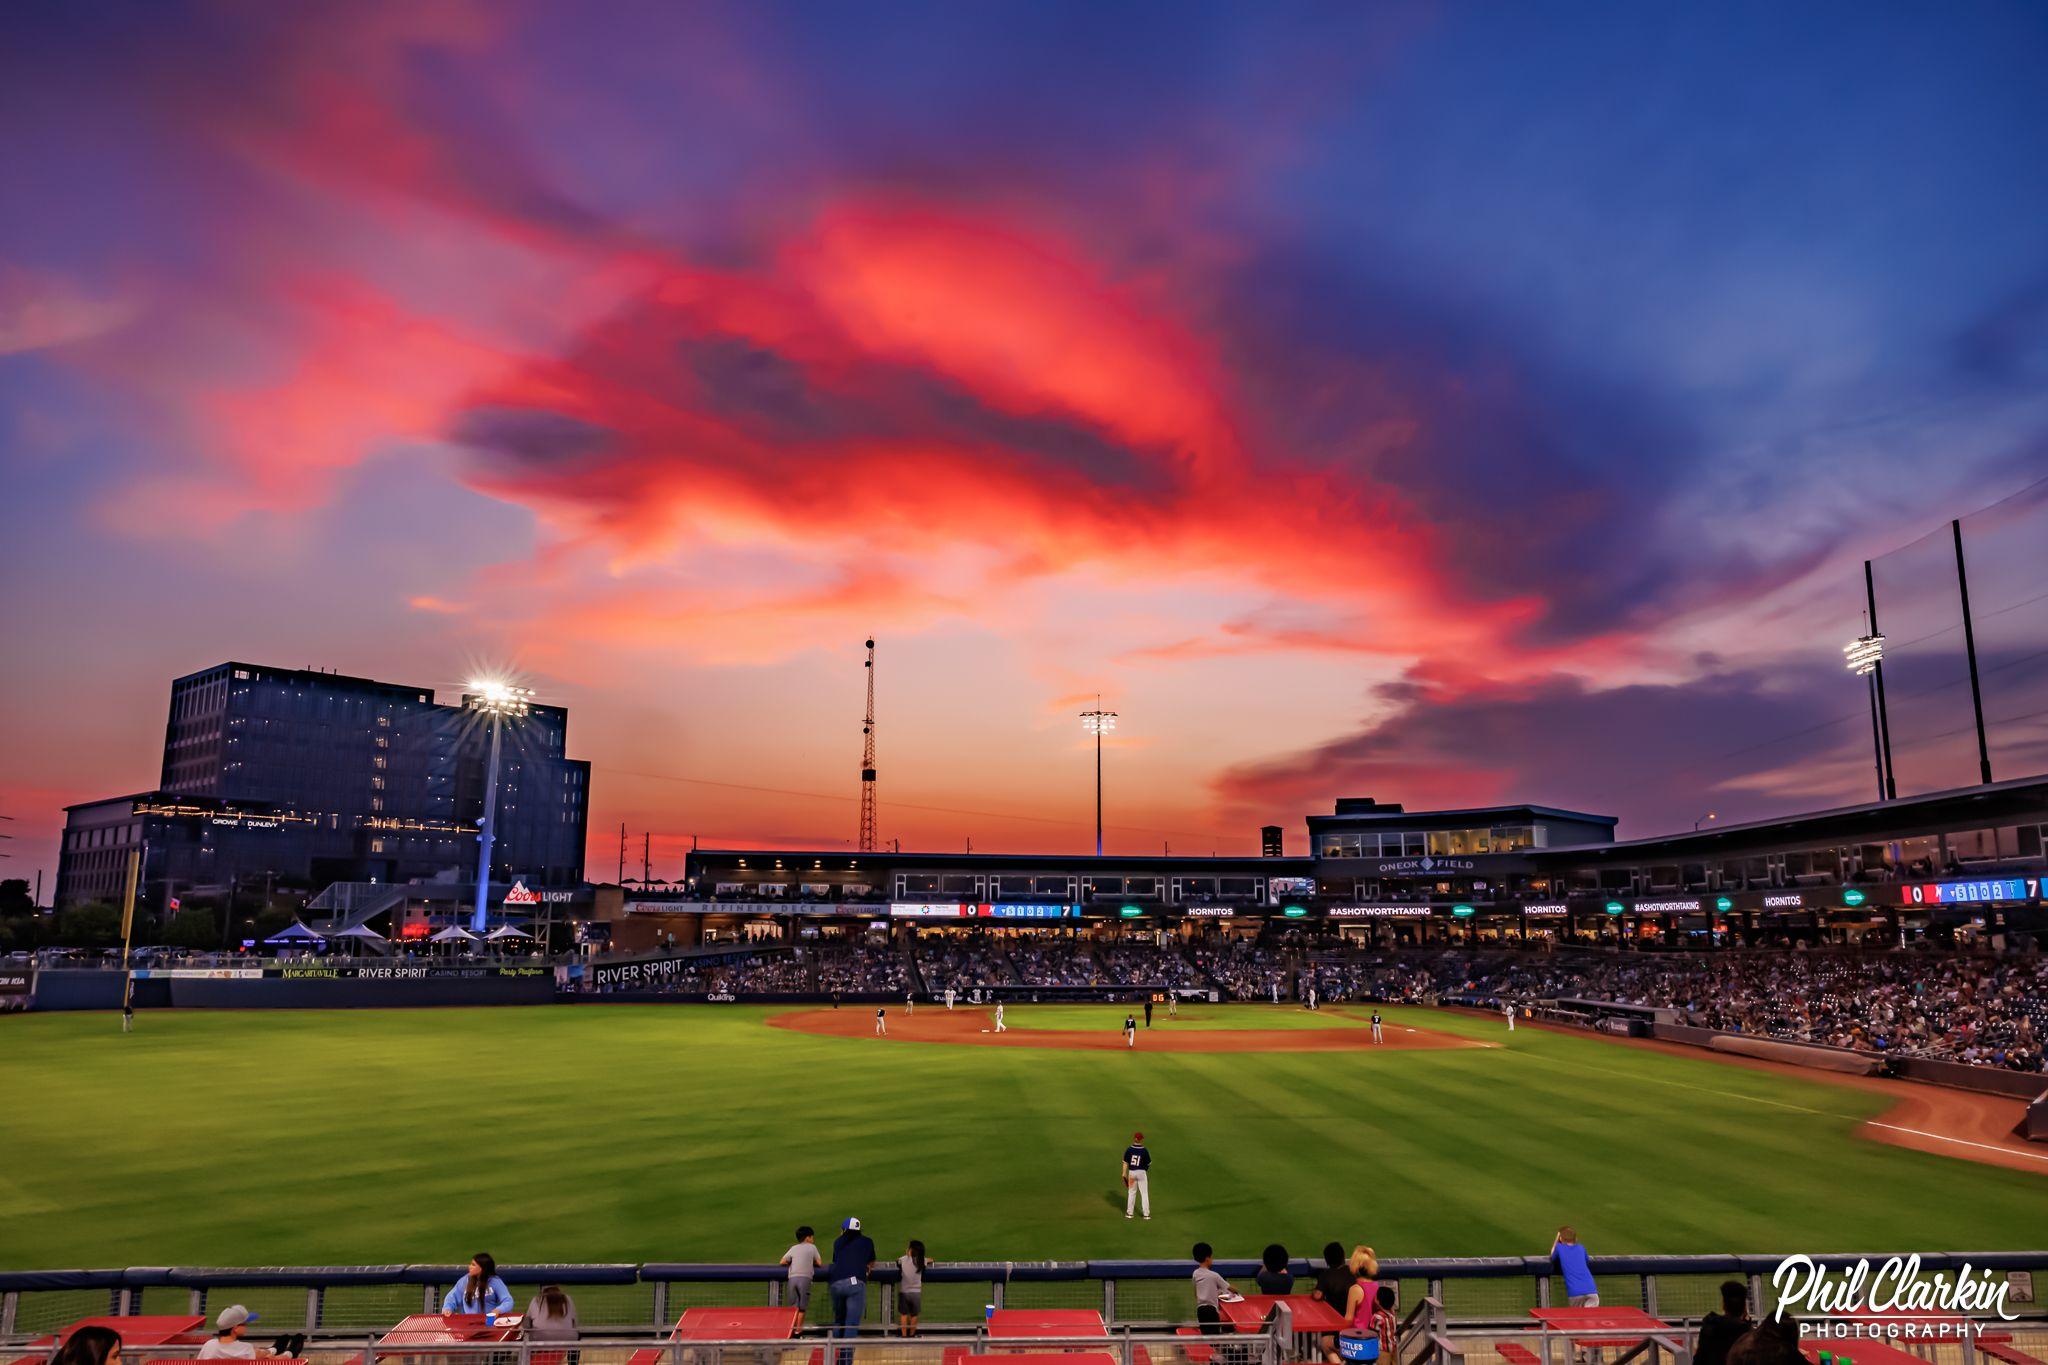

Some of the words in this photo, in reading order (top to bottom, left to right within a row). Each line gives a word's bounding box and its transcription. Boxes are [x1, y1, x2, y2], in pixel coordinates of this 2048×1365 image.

[212, 818, 238, 826] CROWE
[247, 820, 278, 828] DUNLEVY
[1379, 860, 1419, 872] ONEOK
[1437, 859, 1474, 869] FIELD
[370, 876, 377, 885] 2
[505, 886, 542, 903] Coors
[543, 891, 573, 903] LIGHT
[1912, 887, 1923, 903] 0
[2027, 880, 2037, 898] 7
[1765, 895, 1801, 907] HORNITOS
[702, 903, 772, 913] REFINERY
[781, 904, 816, 913] DECK
[967, 905, 976, 915] 0
[1062, 906, 1071, 916] 7
[1329, 907, 1431, 916] #ASHOTWORTHTAKING
[1524, 905, 1567, 914] HORNITOS
[1635, 901, 1700, 912] #ASHOTWORTHTAKING
[1188, 908, 1233, 916] HORNITOS
[358, 968, 392, 978] RIVER
[394, 968, 427, 978] SPIRIT
[430, 969, 459, 977] CASINO
[597, 965, 639, 984] RIVER
[642, 959, 682, 977] SPIRIT
[11, 977, 25, 985] KIA
[707, 993, 735, 1002] QuikTrip
[1130, 1155, 1141, 1167] 51
